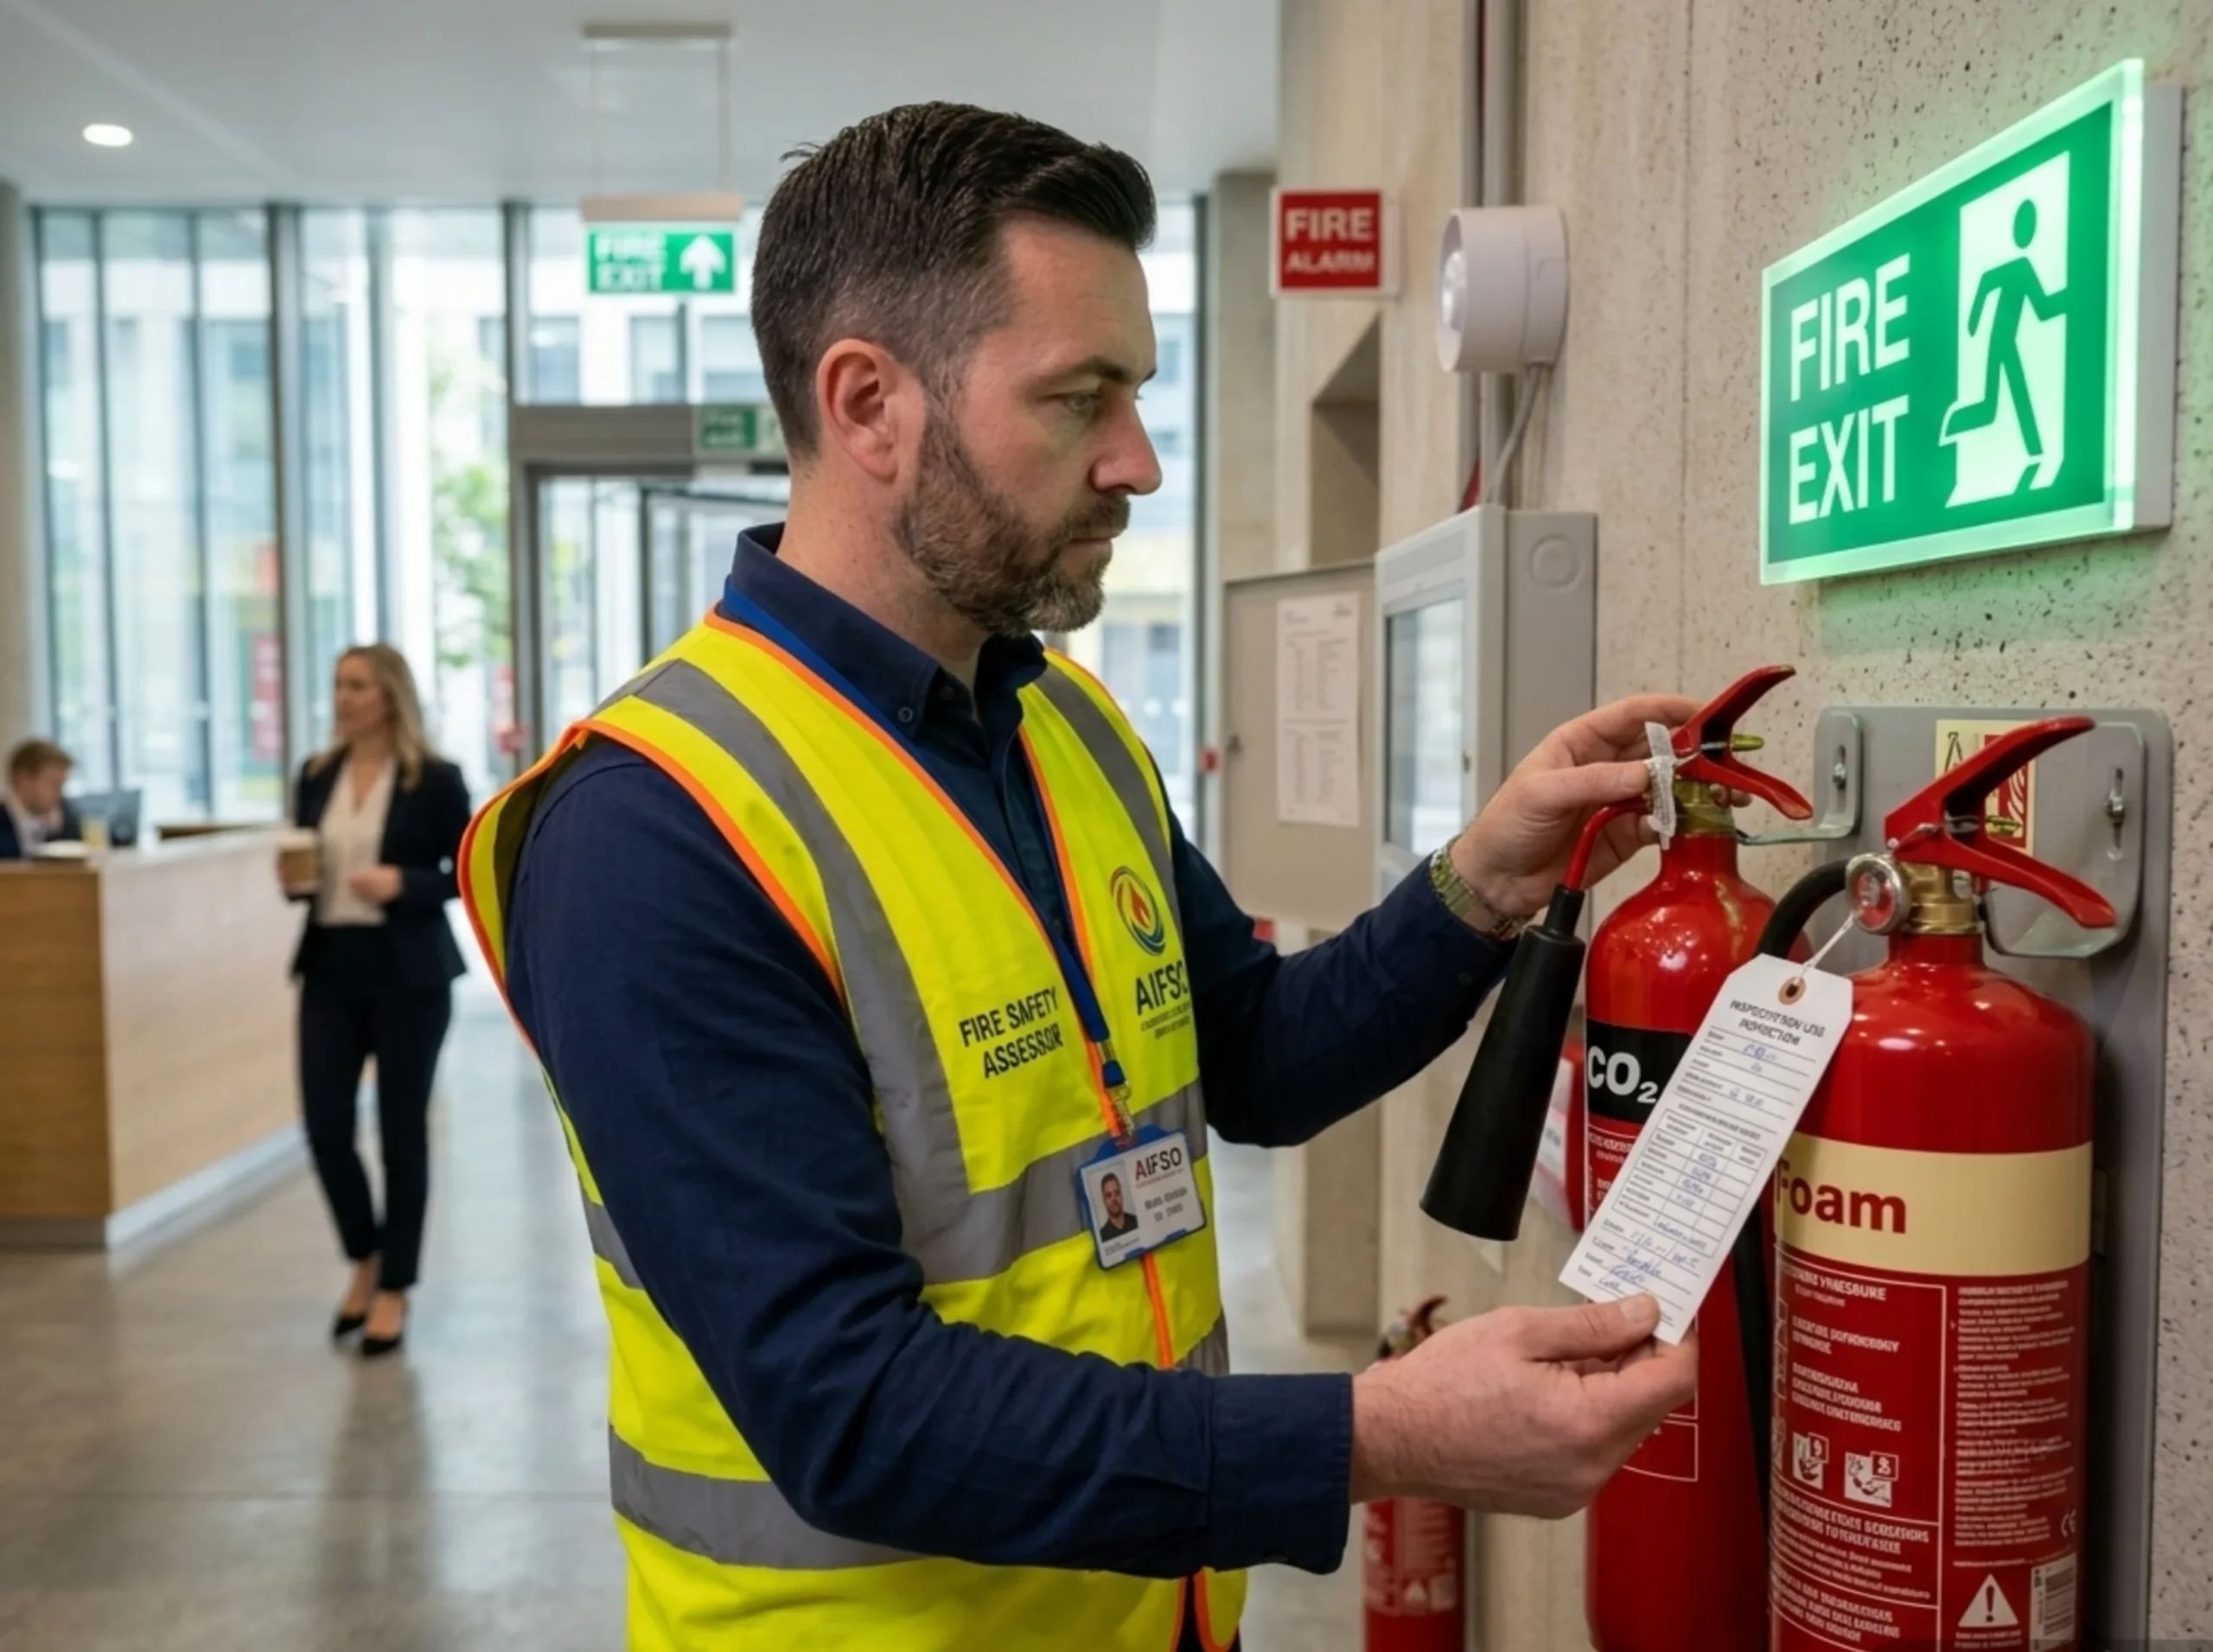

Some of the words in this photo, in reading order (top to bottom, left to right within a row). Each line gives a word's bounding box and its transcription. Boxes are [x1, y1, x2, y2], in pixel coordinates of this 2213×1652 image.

[1285, 207, 1374, 240] FIRE
[1285, 251, 1375, 273] ALARM
[1790, 252, 1910, 403] FIRE
[1789, 394, 1909, 525] EXIT
[959, 1009, 1005, 1047] FIRE
[1005, 986, 1058, 1030] SAFETY
[984, 1023, 1063, 1079] ASSESSOR
[1135, 1147, 1182, 1181] AIFSO
[1776, 1157, 1906, 1234] Foam
